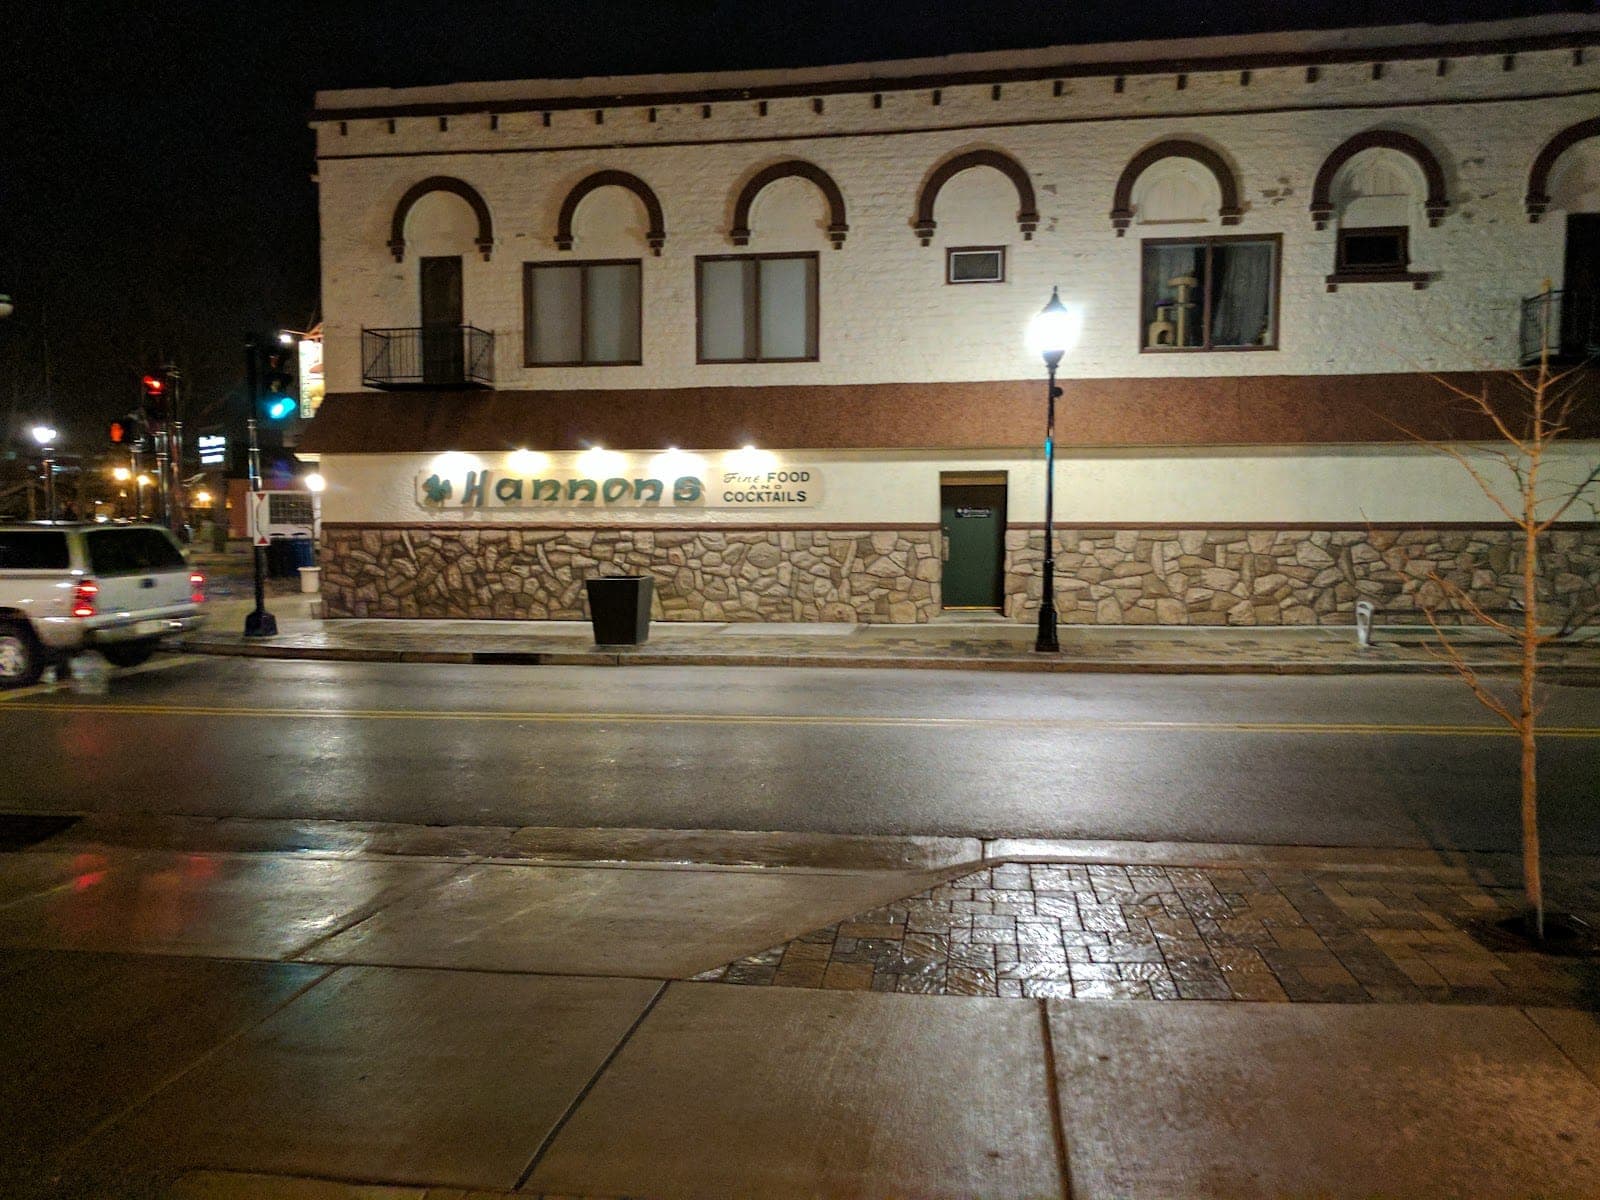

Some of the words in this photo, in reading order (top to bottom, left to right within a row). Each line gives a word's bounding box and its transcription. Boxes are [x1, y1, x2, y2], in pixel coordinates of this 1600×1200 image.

[723, 472, 761, 484] Fine
[767, 471, 811, 483] FOOD
[461, 470, 703, 507] Hannons
[723, 490, 807, 502] COCKTAILS
